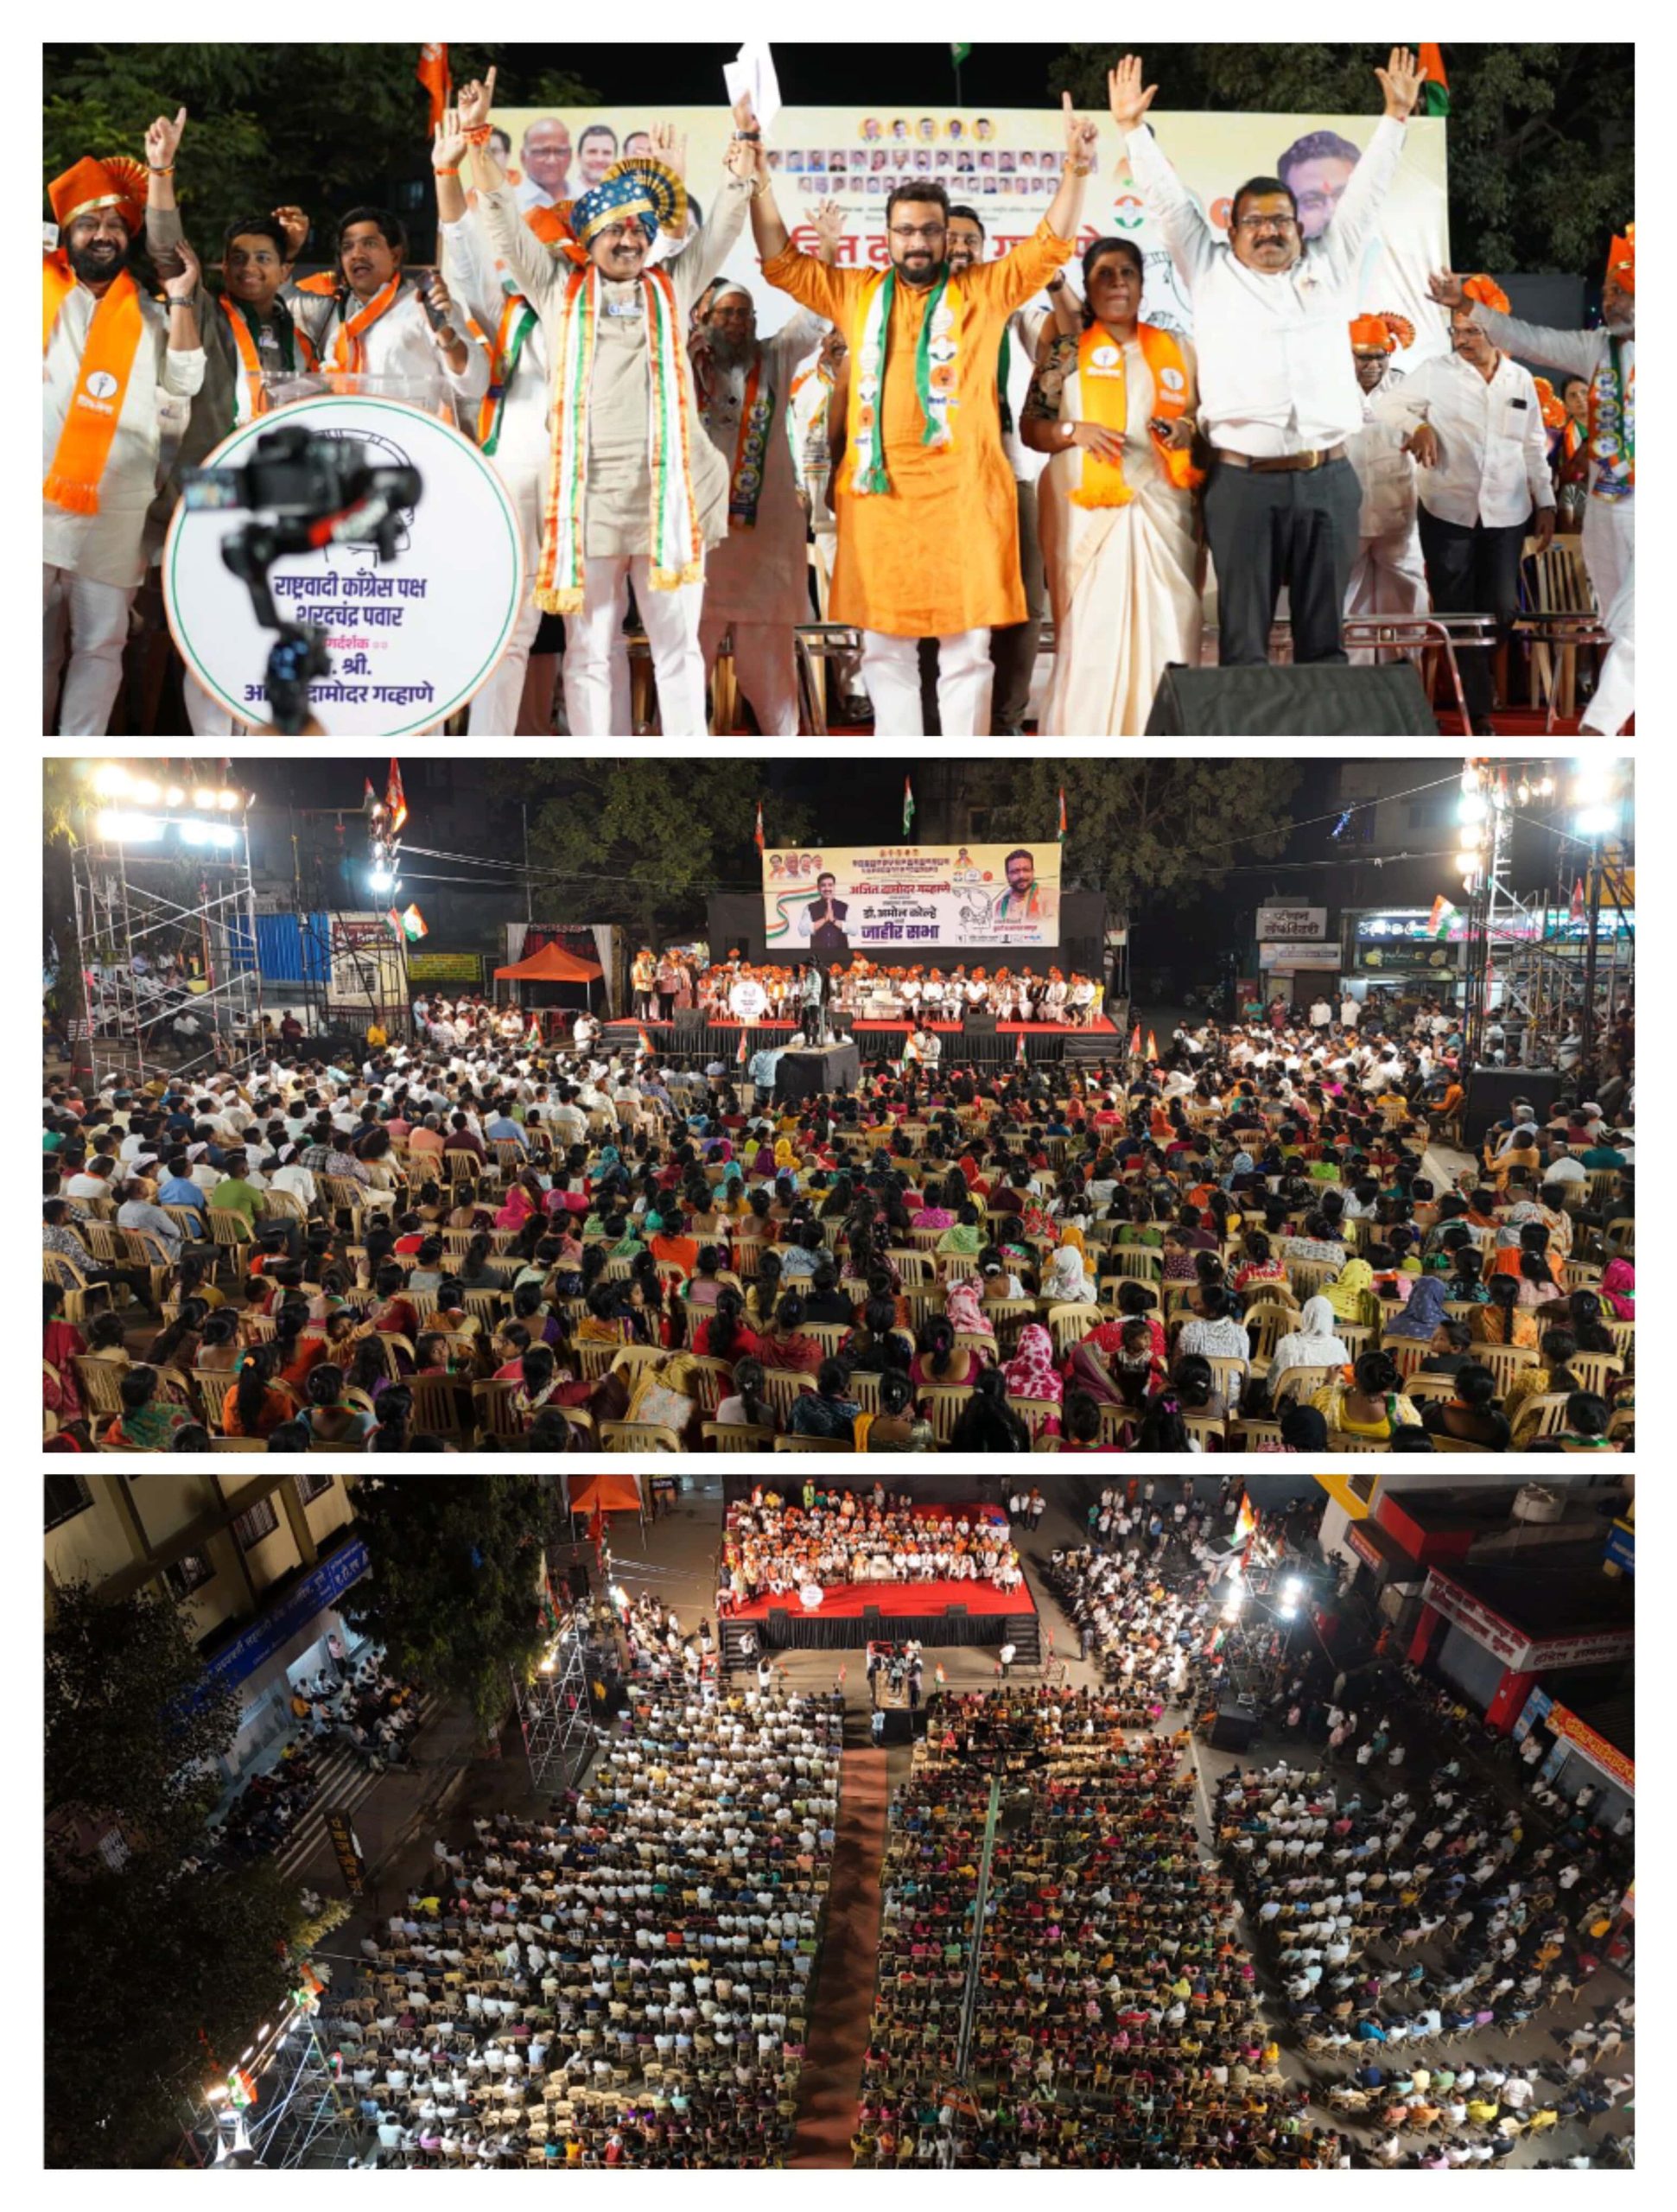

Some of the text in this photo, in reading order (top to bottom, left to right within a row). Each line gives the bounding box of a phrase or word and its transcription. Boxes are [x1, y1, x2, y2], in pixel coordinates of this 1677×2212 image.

[274, 571, 339, 600] राष्ट्रवादी
[397, 578, 427, 598] पक्ष
[362, 606, 404, 627] पवार
[308, 679, 435, 705] दामोदर गव्हाणे
[861, 921, 940, 940] जाहीर सभा
